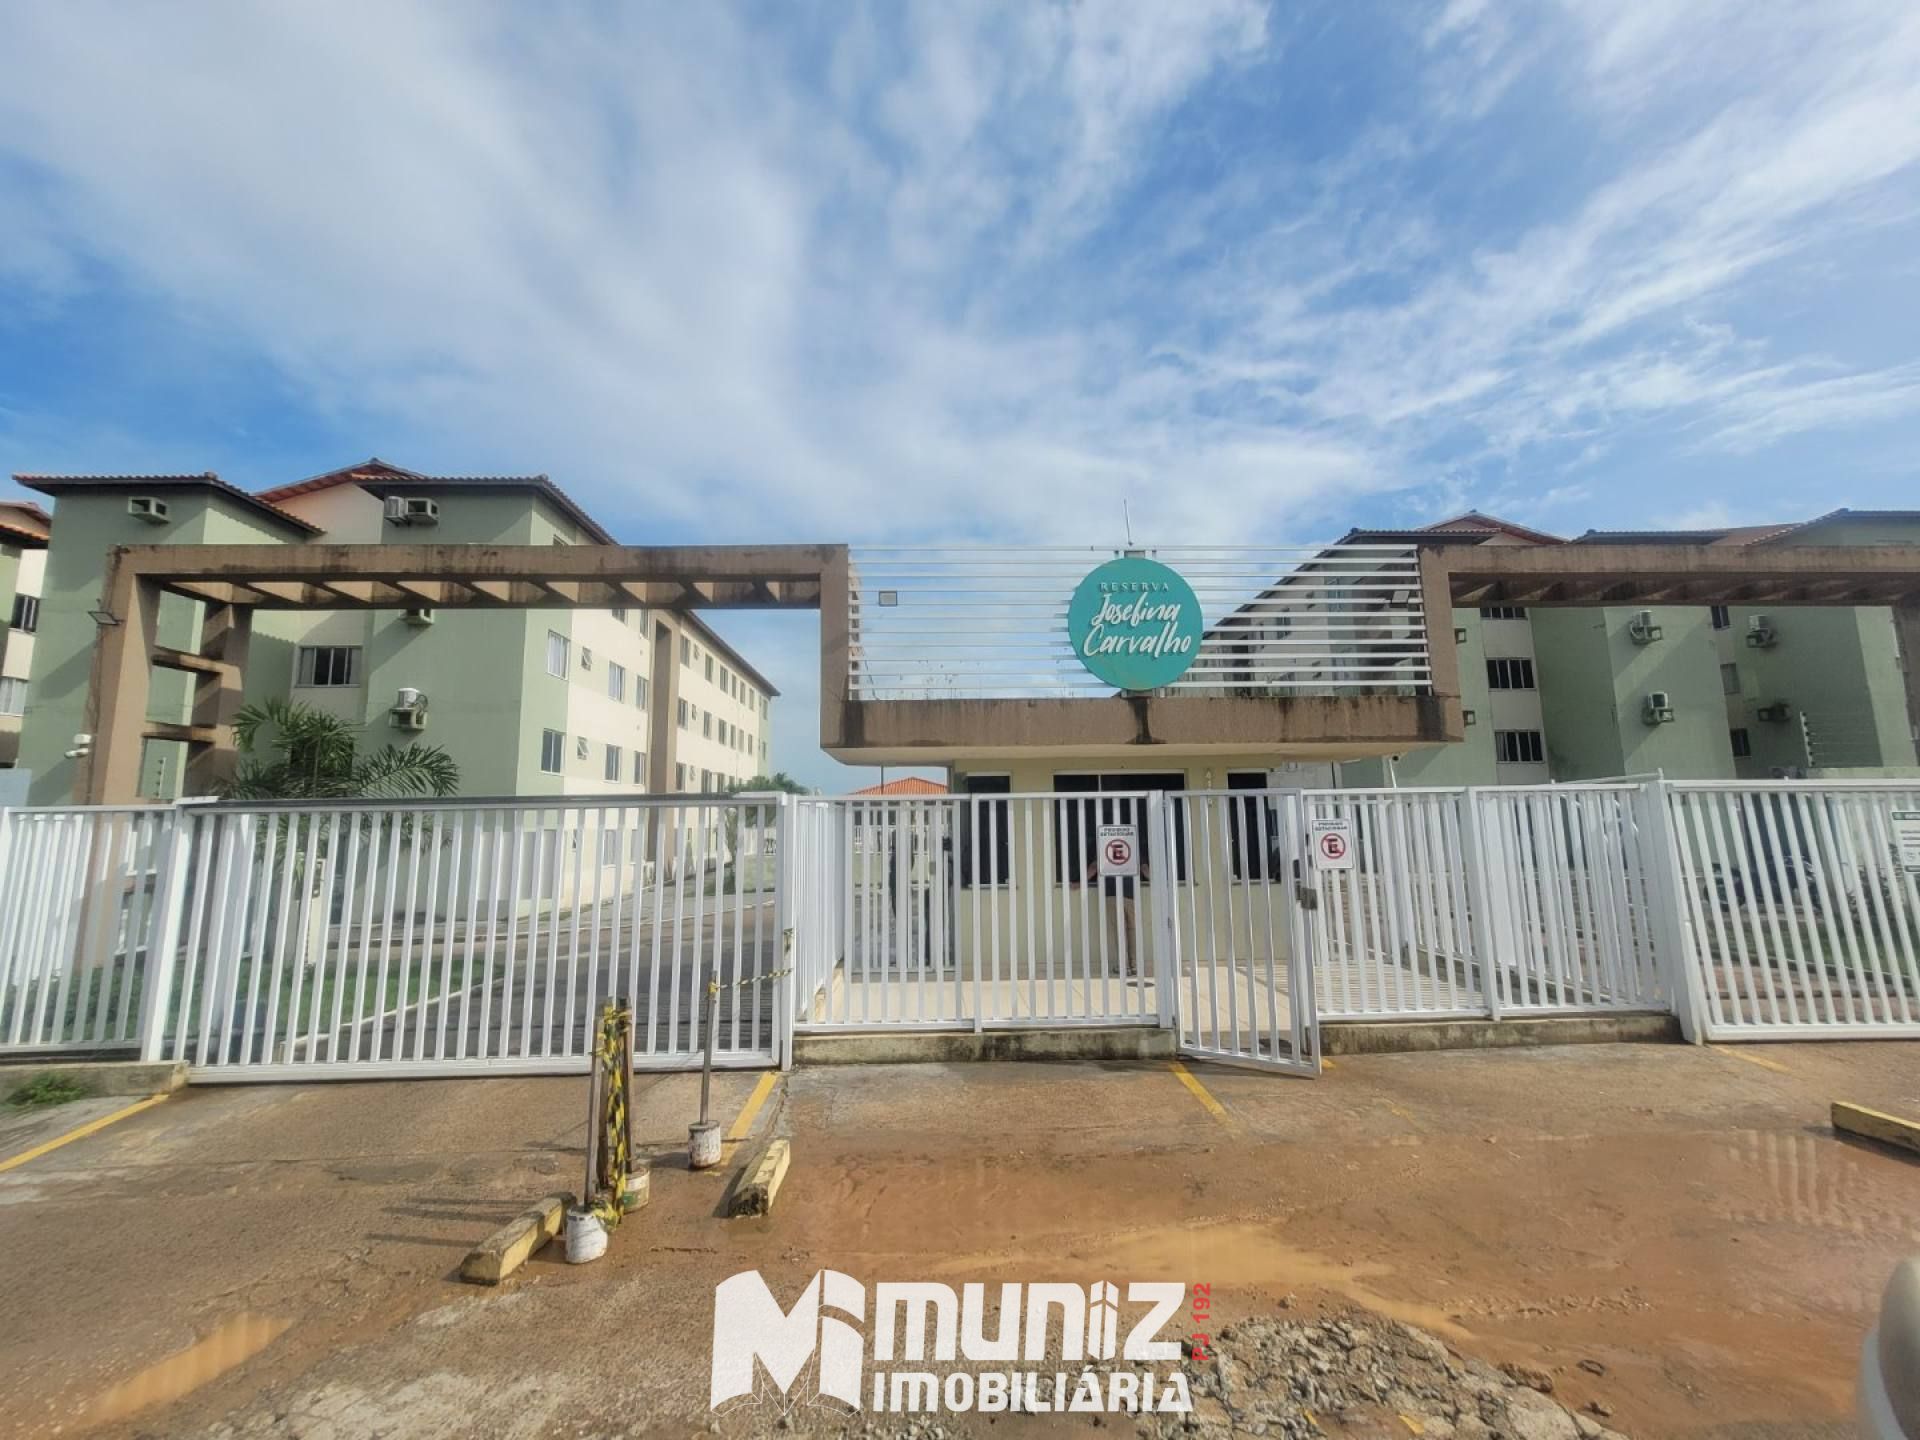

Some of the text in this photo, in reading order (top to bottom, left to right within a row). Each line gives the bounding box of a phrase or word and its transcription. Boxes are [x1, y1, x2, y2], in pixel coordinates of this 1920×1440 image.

[1100, 582, 1169, 592] RESERVA
[1091, 592, 1181, 626] Josefina
[1083, 621, 1192, 658] Carvalho
